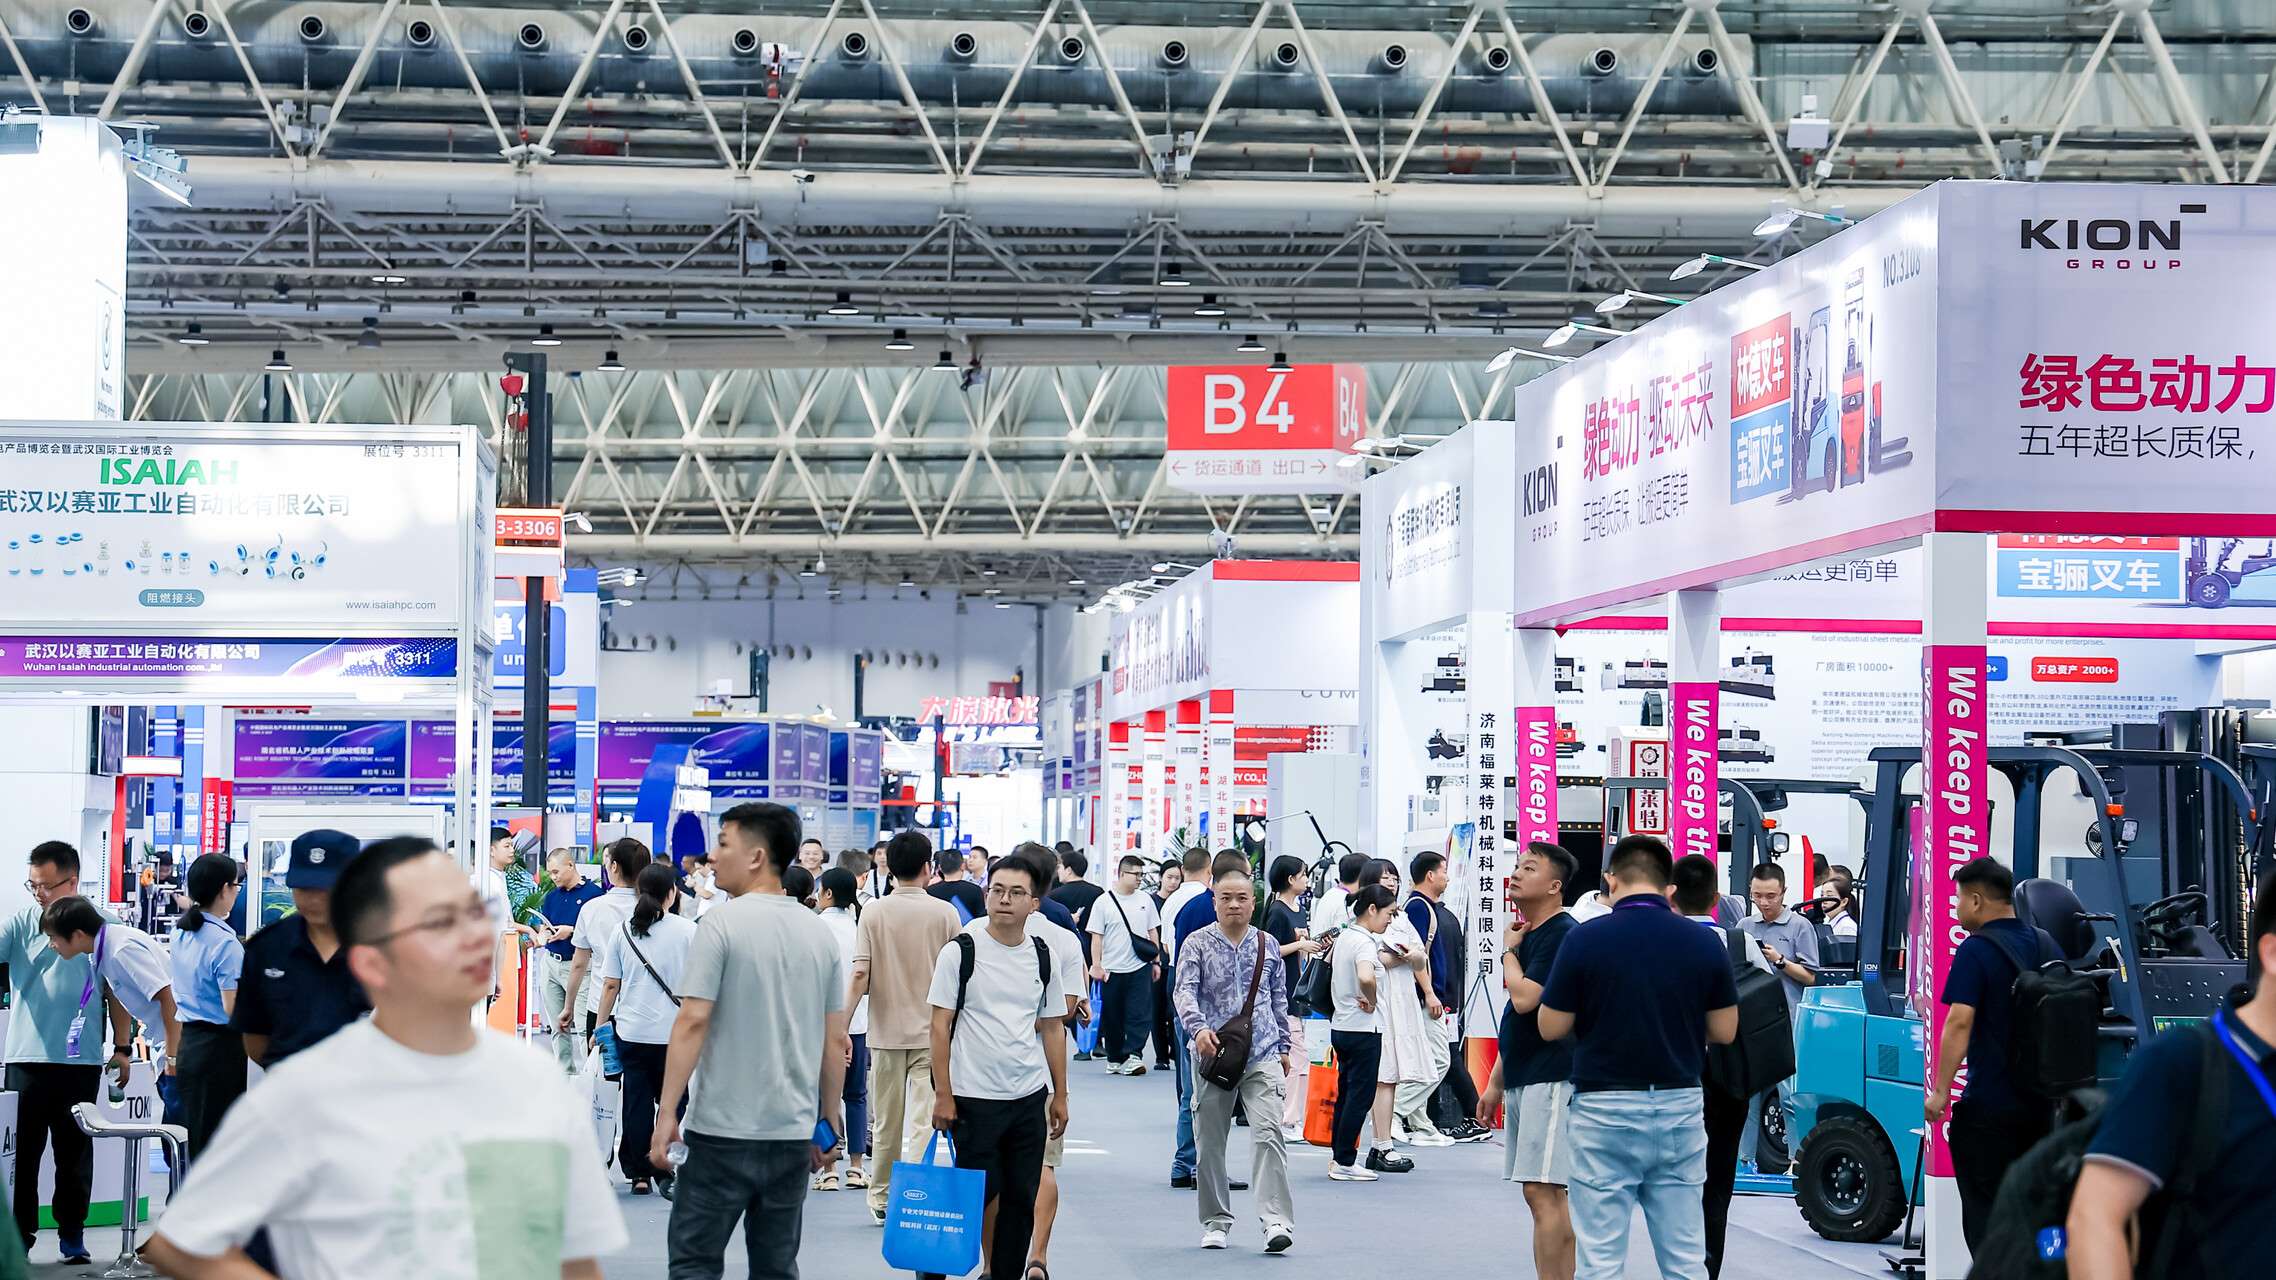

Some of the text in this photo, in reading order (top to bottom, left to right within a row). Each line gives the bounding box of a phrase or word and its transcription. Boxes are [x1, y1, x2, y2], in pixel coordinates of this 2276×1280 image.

[2021, 219, 2180, 250] KION
[2067, 259, 2181, 269] GROUP
[1736, 331, 1786, 402] 林德叉车
[2019, 352, 2276, 414] 绿色动力
[1204, 373, 1295, 434] B4
[1339, 376, 1359, 440] B4
[363, 444, 445, 458] 展位号 3311
[1736, 419, 1786, 489] 宝骊叉车
[100, 458, 239, 485] ISAIAH
[1195, 460, 1305, 476] 货运通道 出口
[0, 490, 350, 517] 武汉以赛亚工业自动化有限公司
[1523, 461, 1558, 518] KION
[1532, 521, 1558, 543] GROUP
[2018, 558, 2161, 592] 宝骊叉车
[147, 592, 195, 603] 阻燃接头
[345, 600, 437, 611] www.isaiahpc.com
[23, 663, 57, 671] Wuhan
[58, 663, 86, 671] Isaiah
[87, 663, 131, 671] Industrial
[132, 663, 184, 672] automation
[25, 643, 261, 660] 武汉以赛亚工业自动化有限公司
[396, 651, 431, 665] 3311
[1858, 663, 1894, 672] 10000+
[2036, 663, 2115, 676] 万总资产 2000+
[1948, 667, 1977, 719] We
[1687, 699, 1711, 742] We
[1528, 720, 1550, 758] We
[1681, 747, 1712, 820] keep
[1941, 727, 1978, 816] keep
[1525, 764, 1554, 824] keep
[1478, 713, 1496, 974] 济南福莱特机械科技有限公司
